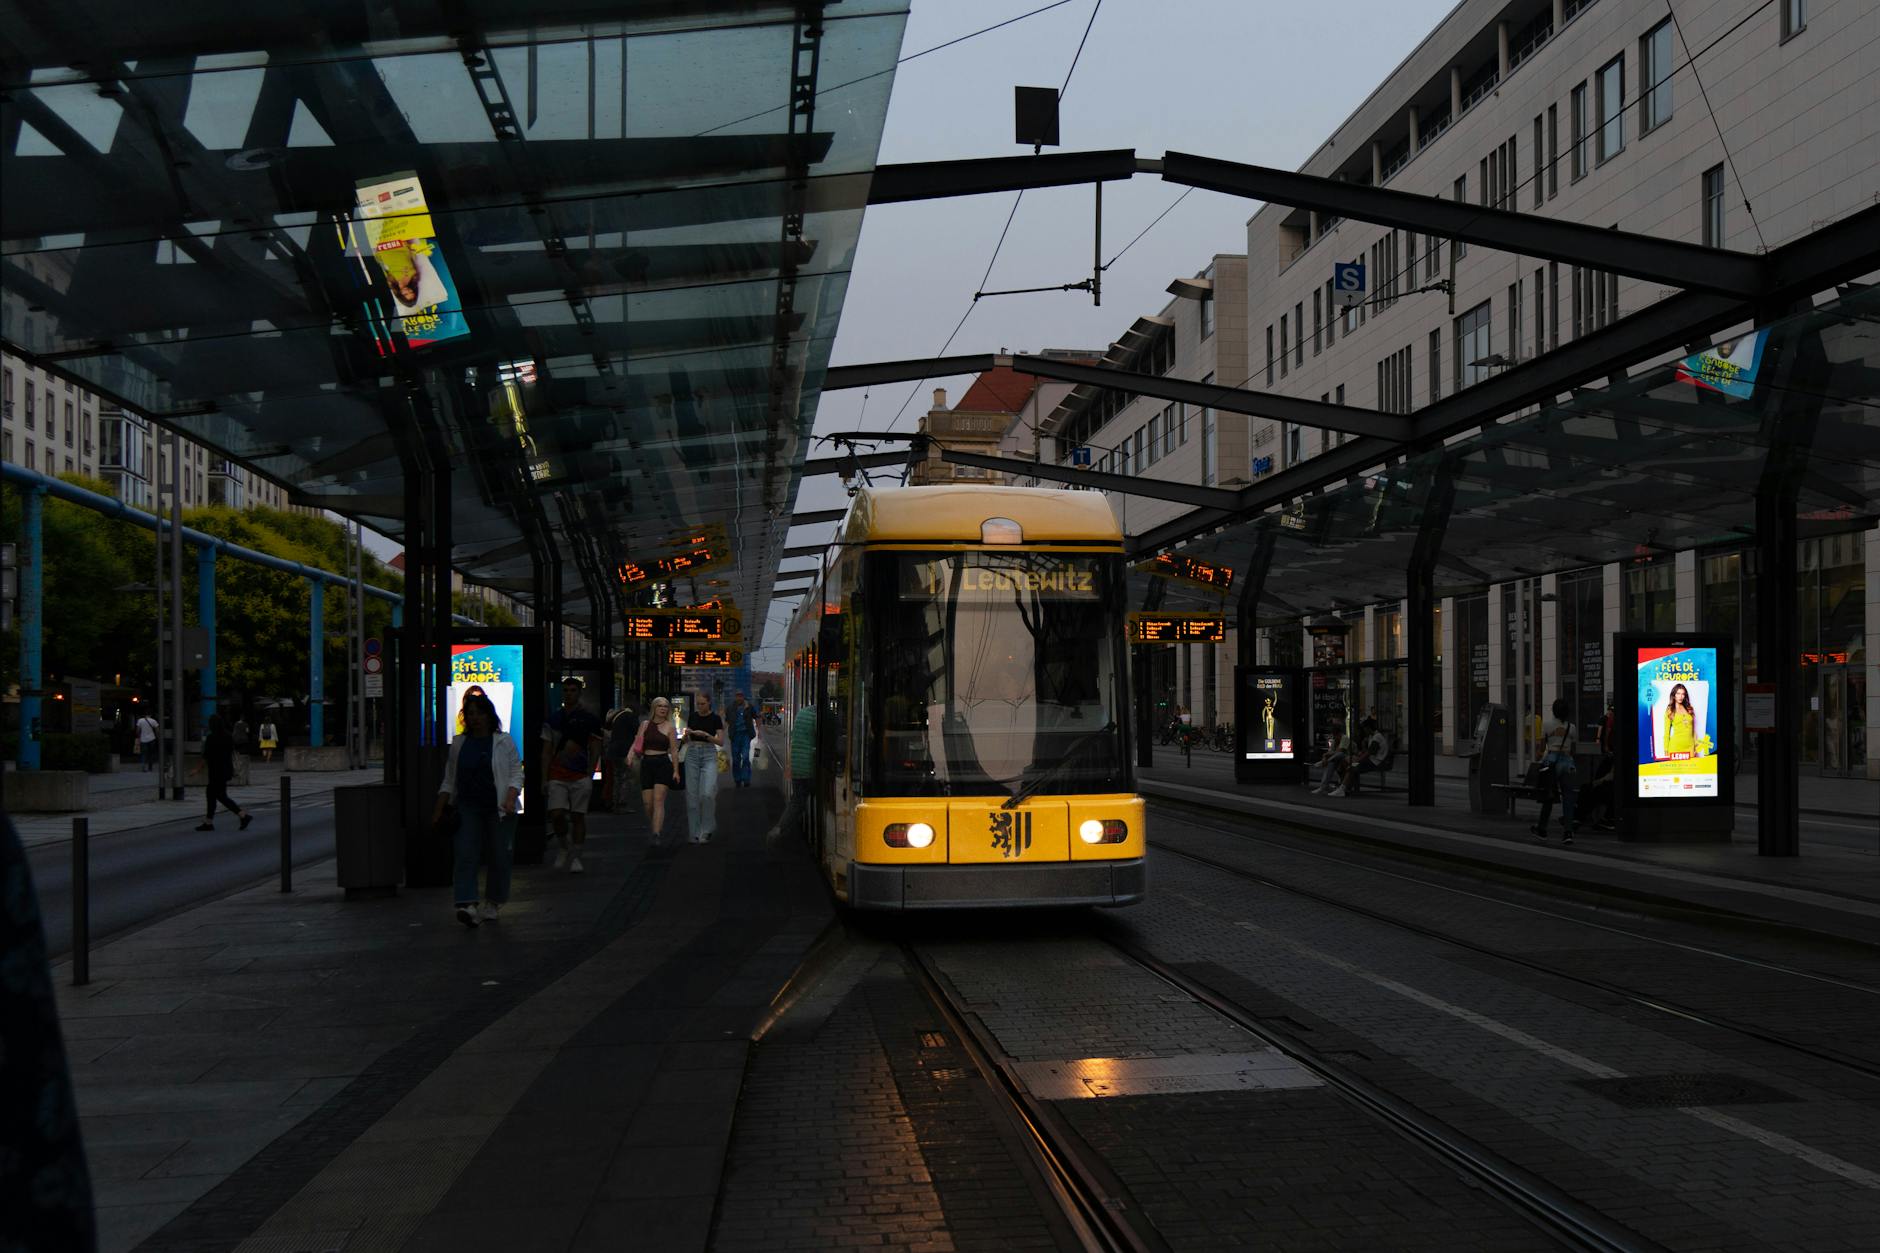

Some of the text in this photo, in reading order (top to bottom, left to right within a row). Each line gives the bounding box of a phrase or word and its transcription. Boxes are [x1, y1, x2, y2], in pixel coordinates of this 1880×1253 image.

[1341, 267, 1360, 291] S
[1077, 450, 1087, 464] T
[963, 562, 1093, 591] Leutewitz
[479, 660, 494, 673] DE
[1683, 662, 1694, 673] DE
